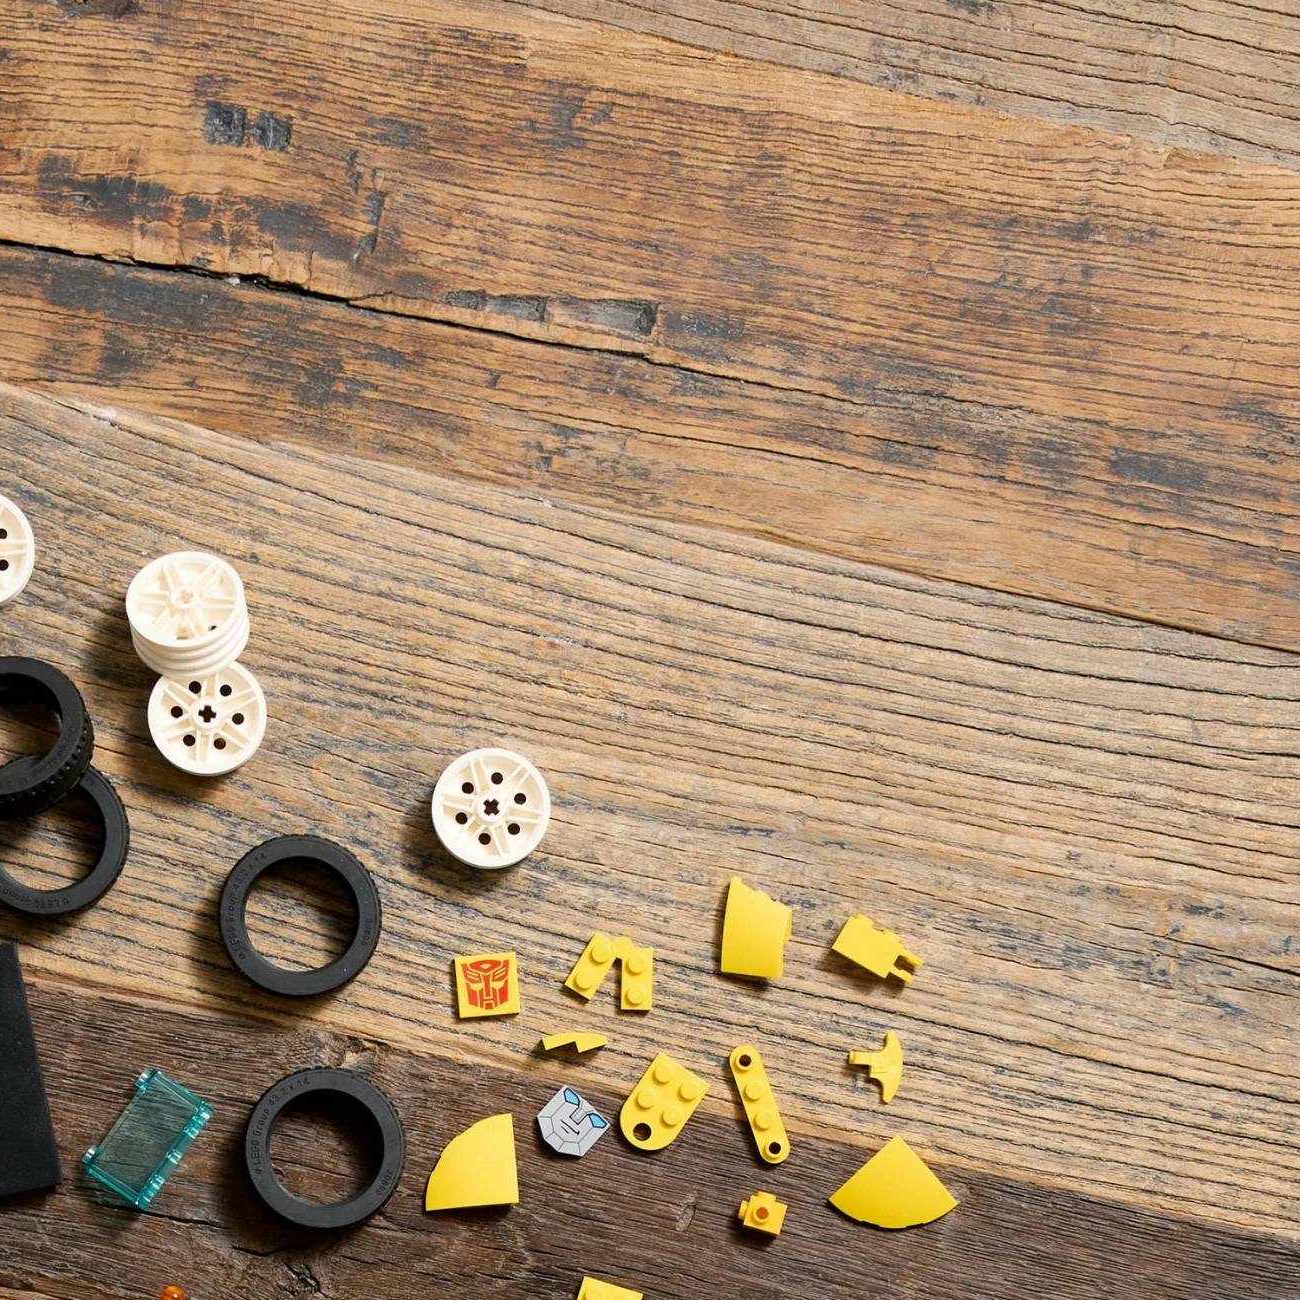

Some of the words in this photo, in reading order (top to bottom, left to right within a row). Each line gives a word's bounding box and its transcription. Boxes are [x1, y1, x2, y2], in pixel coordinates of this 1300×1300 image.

[297, 1076, 309, 1087] 14
[268, 1087, 287, 1107] 43.2
[253, 1108, 270, 1136] Group
[251, 1139, 261, 1165] LEGO
